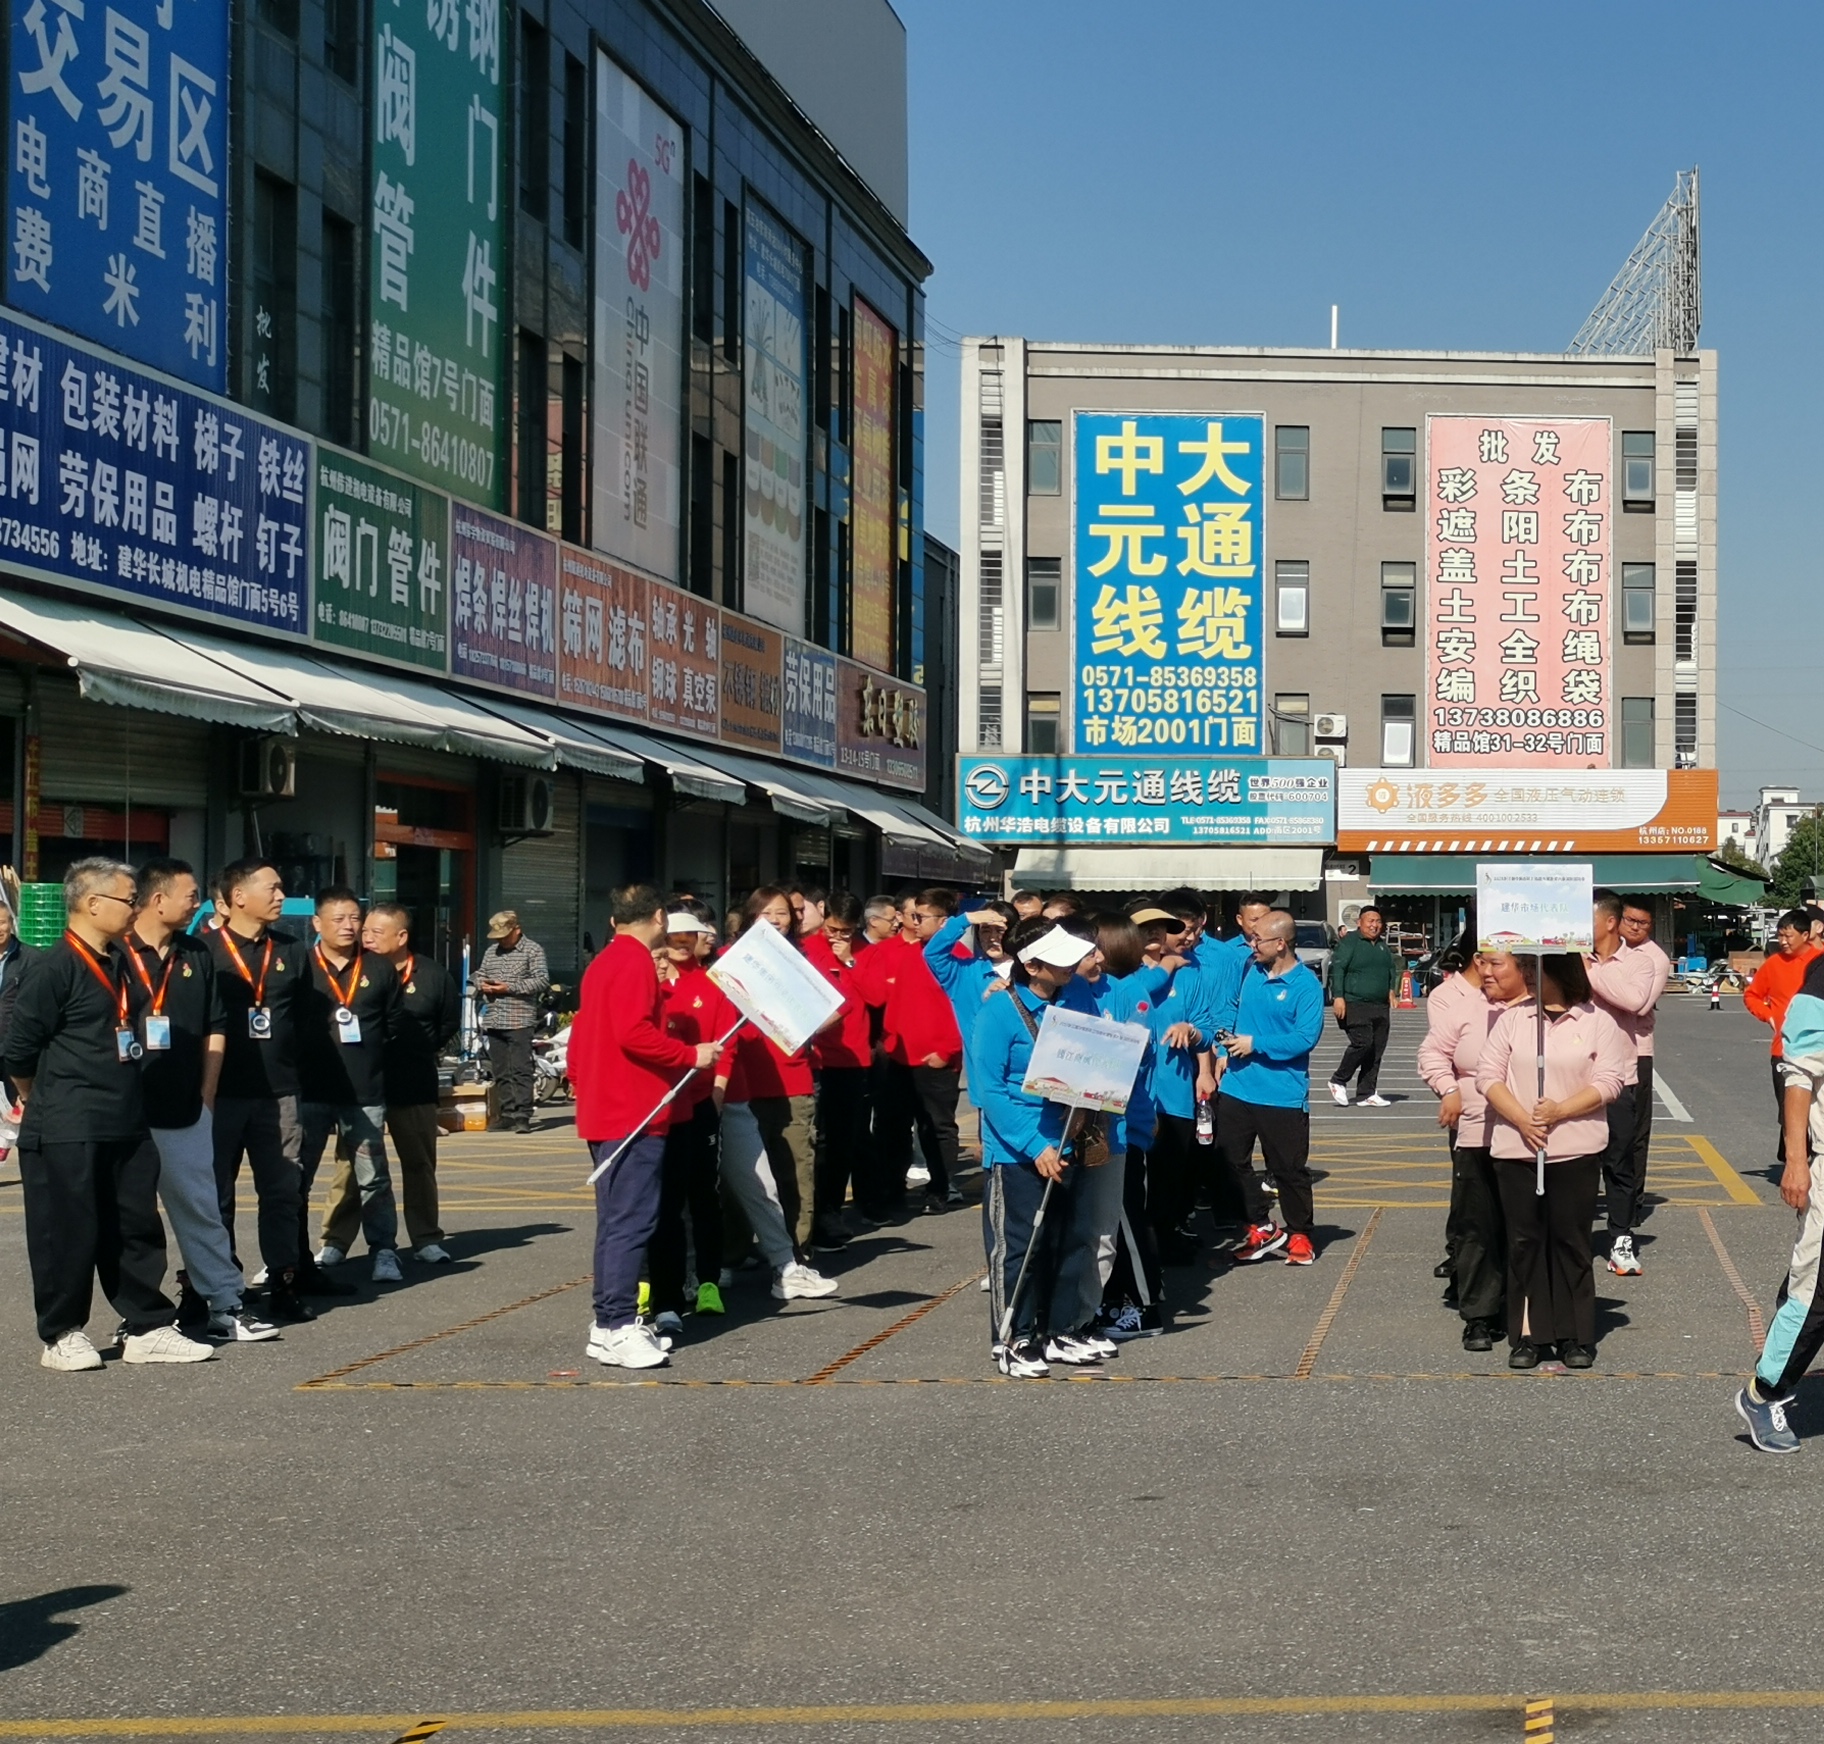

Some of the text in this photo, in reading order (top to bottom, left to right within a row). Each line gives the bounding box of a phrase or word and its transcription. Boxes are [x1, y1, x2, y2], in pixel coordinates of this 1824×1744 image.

[18, 0, 219, 199] 交易区
[376, 22, 499, 223] 阀门
[15, 114, 218, 287] 电商直播
[372, 168, 499, 358] 管件
[13, 204, 218, 368] 费米利
[370, 318, 496, 433] 精品馆7号门面
[60, 359, 180, 462] 包装材料
[193, 407, 246, 483] 梯子
[257, 434, 305, 505] 铁丝
[633, 304, 650, 532] 中国联通
[368, 397, 496, 492] 0571-86410807
[623, 399, 634, 522] unicom
[1096, 420, 1253, 497] 中大
[1436, 466, 1603, 506] 彩条布
[59, 448, 178, 547] 劳保用品
[192, 490, 244, 565] 螺杆
[256, 512, 304, 580] 钉子
[1436, 507, 1603, 546] 遮阳布
[322, 502, 442, 616] 阀门管件
[1086, 503, 1257, 578] 元通
[117, 543, 300, 624] 建华长城机电精品馆门面5号6号
[1436, 547, 1603, 586] 盖土布
[652, 593, 678, 647] 轴承
[1090, 584, 1253, 660] 线缆
[1436, 588, 1602, 626] 土工布
[561, 587, 646, 678] 筛网滤布
[1436, 628, 1602, 666] 安全绳
[682, 666, 717, 716] 真空泵
[784, 650, 837, 725] 劳保用品
[1081, 665, 1258, 688] 0571-85369358
[1435, 668, 1602, 706] 编织袋
[1082, 688, 1258, 714] 13705816521
[1433, 707, 1604, 728] 13738086886
[1082, 714, 1257, 748] 市场2001门面
[1432, 730, 1605, 756] 精品馆31-32号门面
[1019, 768, 1242, 805] 中大元通线缆
[1248, 776, 1329, 789] 世界500强企业
[1406, 781, 1488, 809] 液多多
[1494, 787, 1626, 803] 全国液压气动连锁
[964, 816, 1171, 835] 杭州华浩电缆设备有限公司
[1192, 827, 1250, 835] 13705816521
[1407, 813, 1473, 824] 全国服务热线
[1638, 836, 1709, 845] 13357110627
[1348, 864, 1357, 875] 2
[1501, 902, 1569, 913] 建华市场代表队
